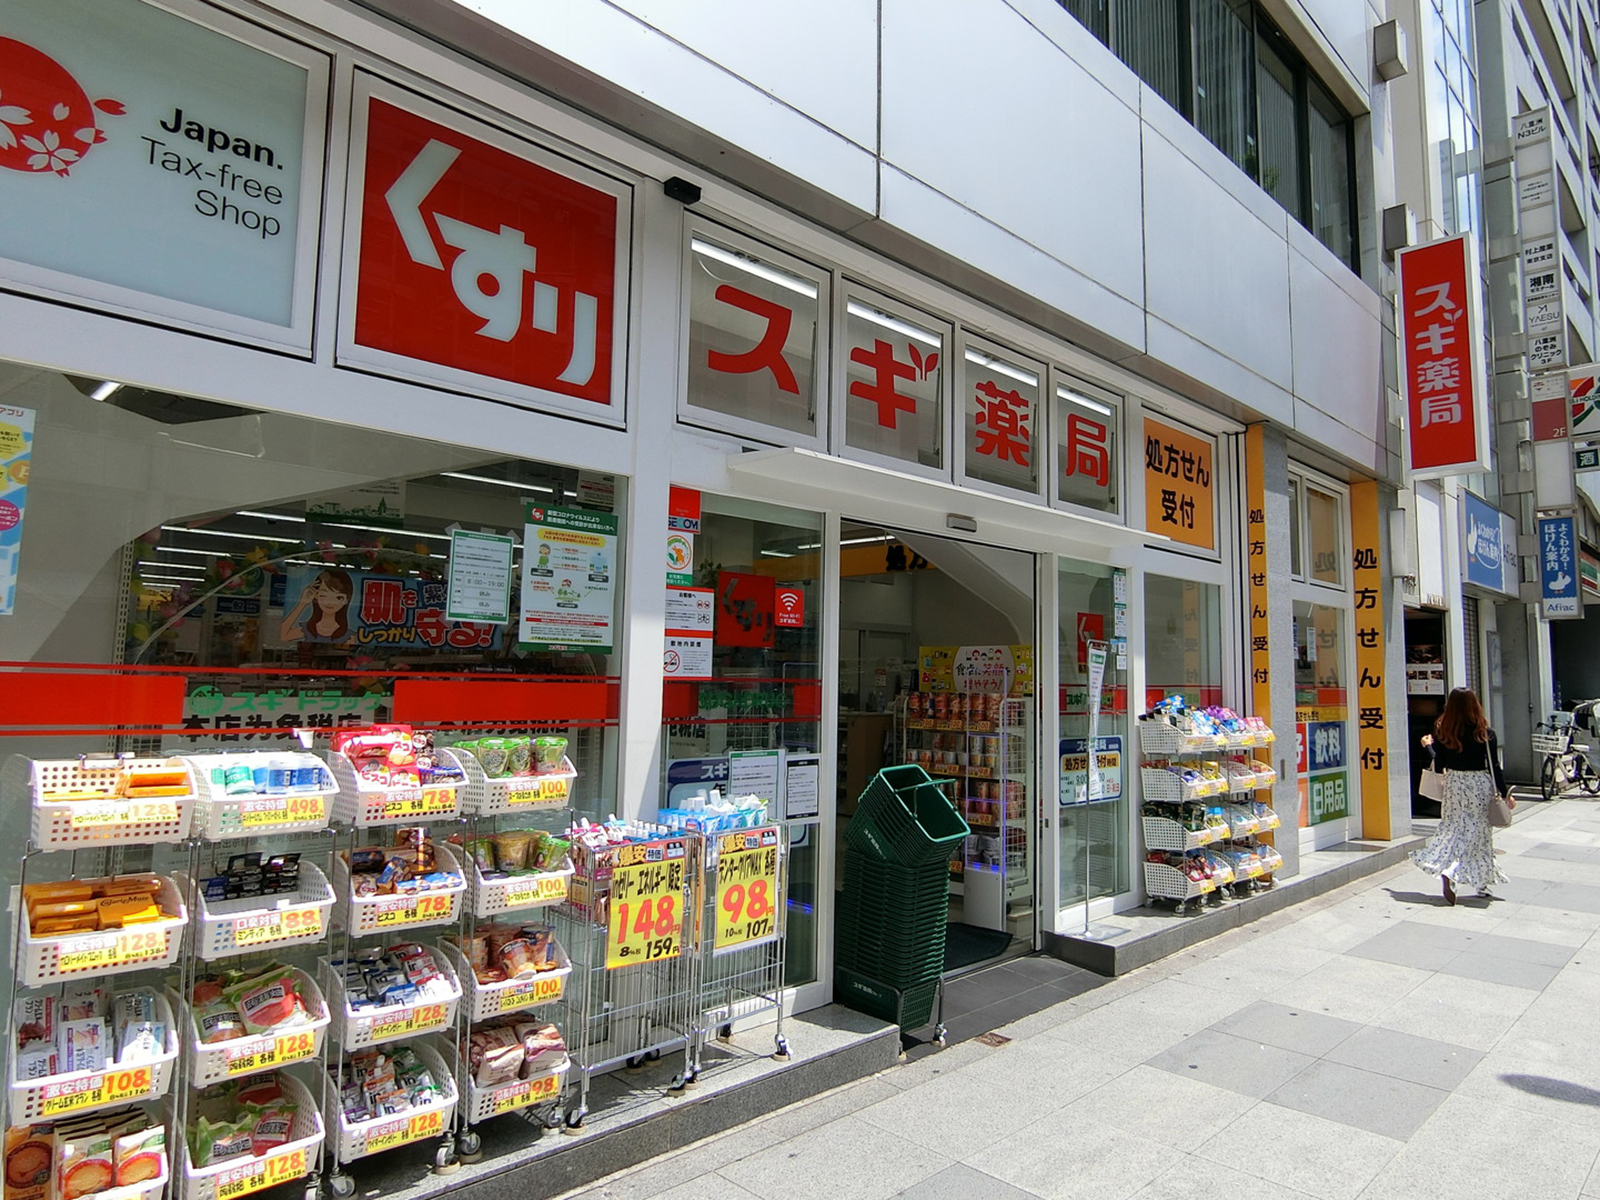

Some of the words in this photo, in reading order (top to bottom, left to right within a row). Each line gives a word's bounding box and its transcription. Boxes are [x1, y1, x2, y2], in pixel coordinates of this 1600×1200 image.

[160, 108, 283, 170] Japan.
[1517, 126, 1546, 140] N3ビル
[141, 136, 283, 205] Tax-free
[194, 189, 281, 239] Shop
[384, 138, 598, 386] くすり
[1528, 312, 1560, 324] YAESU
[1414, 281, 1464, 428] スギ薬局
[1530, 350, 1562, 360] クリニック
[707, 282, 1110, 488] スギ薬局
[1553, 427, 1566, 438] 2F
[1145, 434, 1210, 488] 処方せん
[1580, 452, 1594, 466] 酒
[1160, 488, 1195, 530] 受付
[1544, 524, 1559, 571] ほけん案内
[361, 580, 418, 625] 肌を
[1250, 508, 1268, 684] 処方せん受付
[1547, 603, 1575, 612] Aflac
[358, 626, 416, 644] しっかり
[1354, 548, 1384, 770] 処方せん受付
[229, 688, 392, 712] スギドラッグ
[1314, 727, 1340, 764] 飲料
[362, 771, 388, 784] ビスコ
[385, 802, 402, 812] ビスコ
[1313, 778, 1346, 816] 日用品
[378, 912, 396, 922] ビスコ
[404, 908, 418, 919] 各種
[238, 928, 266, 941] ミンティア
[260, 1052, 275, 1064] 各種
[46, 1076, 104, 1098] 激安特価
[250, 1174, 266, 1188] 各種
